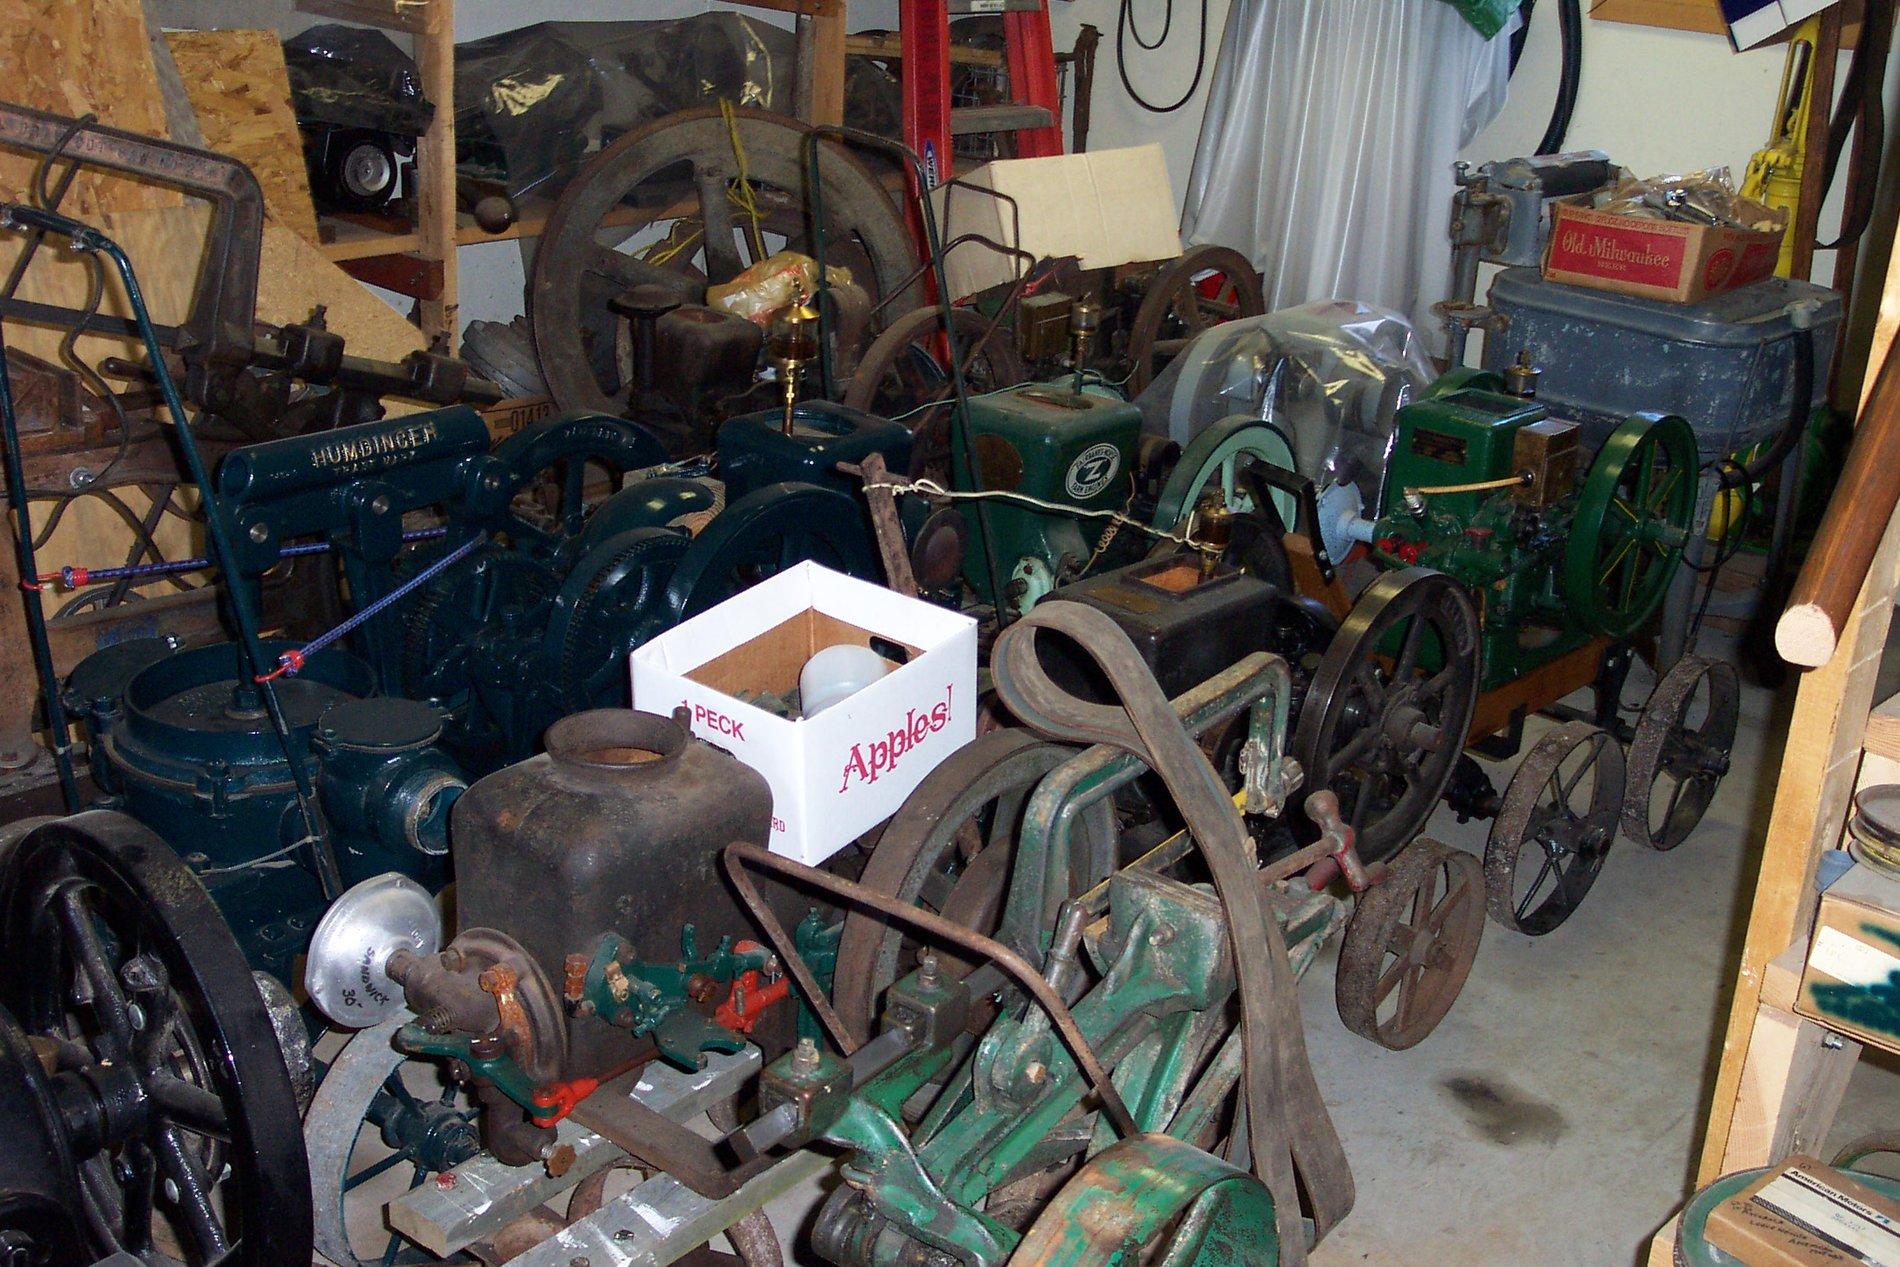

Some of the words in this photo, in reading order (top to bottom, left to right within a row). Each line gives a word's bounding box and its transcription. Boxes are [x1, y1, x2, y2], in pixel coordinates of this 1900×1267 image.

[1562, 229, 1587, 254] Old
[1588, 234, 1670, 269] Milwaukee
[311, 420, 437, 469] HUMDINGER
[1083, 459, 1108, 482] Z
[695, 703, 746, 741] PECK
[839, 684, 953, 793] Apples!
[770, 816, 786, 833] RD
[1791, 1170, 1837, 1197] American
[1837, 1193, 1873, 1216] Motors
